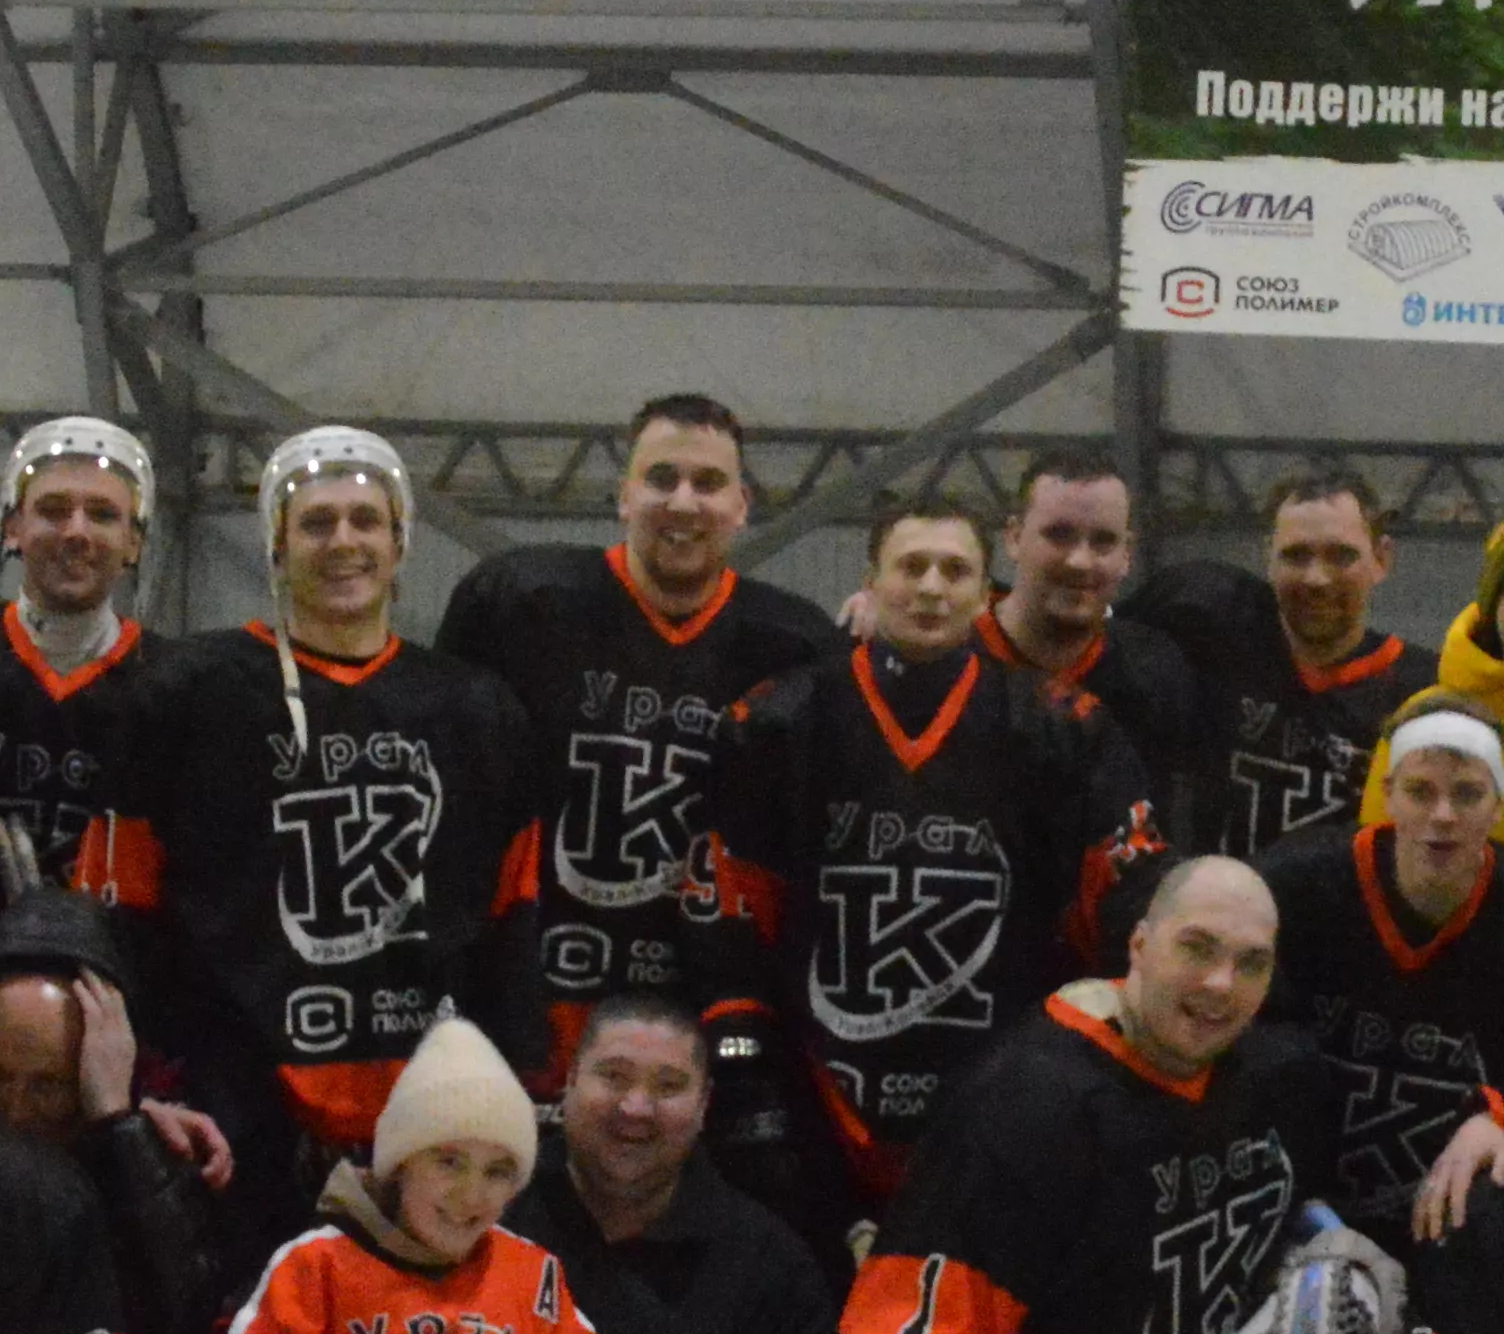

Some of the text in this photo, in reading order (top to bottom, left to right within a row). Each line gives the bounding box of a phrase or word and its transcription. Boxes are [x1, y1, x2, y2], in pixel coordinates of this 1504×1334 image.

[1196, 70, 1445, 128] Поддержи
[1196, 191, 1315, 221] СИГМА
[1348, 192, 1472, 247] СТРОЙКОМПЛЕКС
[1236, 275, 1300, 292] СОЮЗ
[1234, 294, 1340, 313] ПОЛИМЕР
